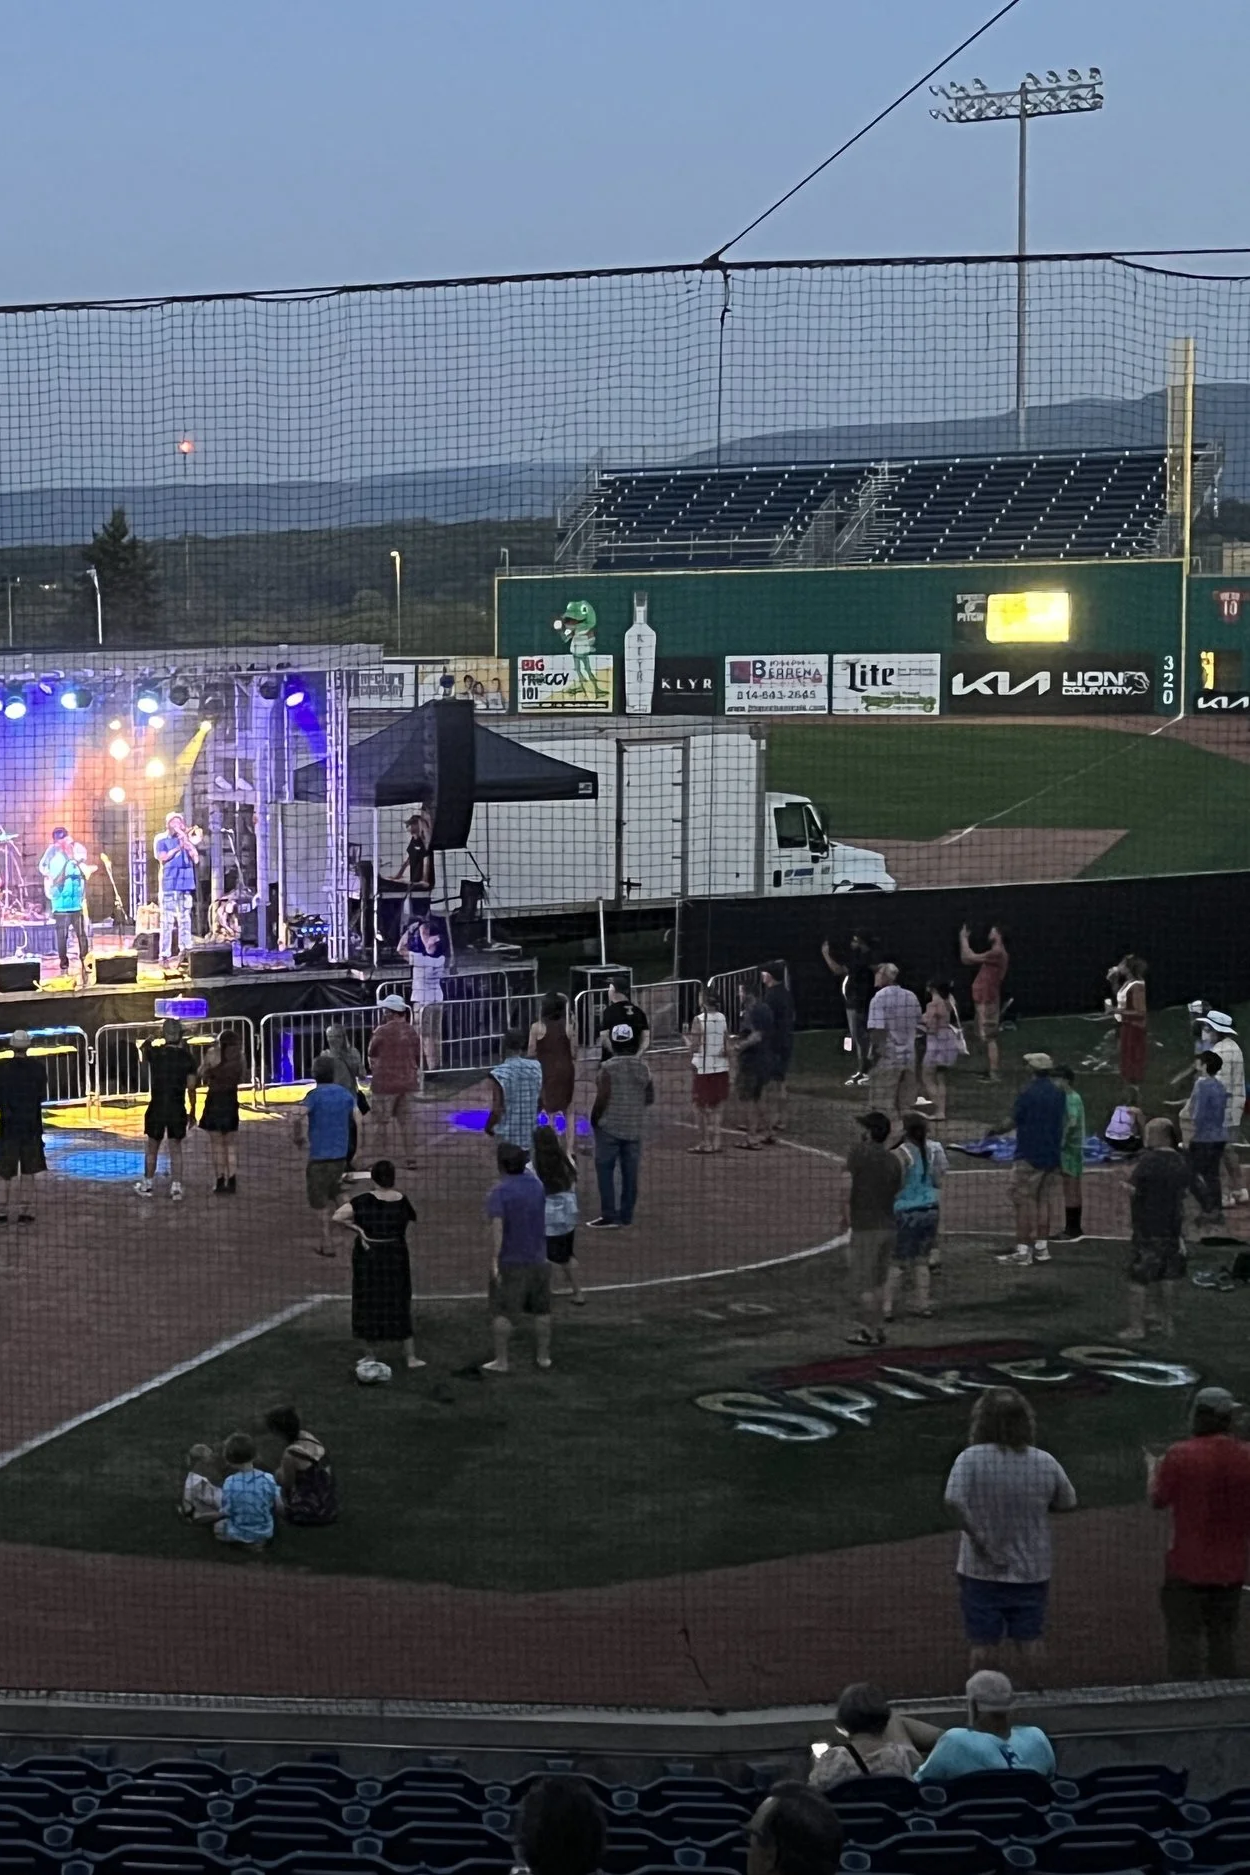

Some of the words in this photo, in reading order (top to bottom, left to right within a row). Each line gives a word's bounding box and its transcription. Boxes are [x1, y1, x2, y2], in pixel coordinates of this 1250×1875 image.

[521, 658, 545, 671] BIG
[841, 659, 895, 692] Lite
[1062, 671, 1125, 686] LION
[661, 678, 713, 690] KLYR
[952, 671, 1050, 695] KIA
[521, 686, 539, 700] 101
[1062, 687, 1134, 696] COUNTRY
[1197, 696, 1250, 709] KIA
